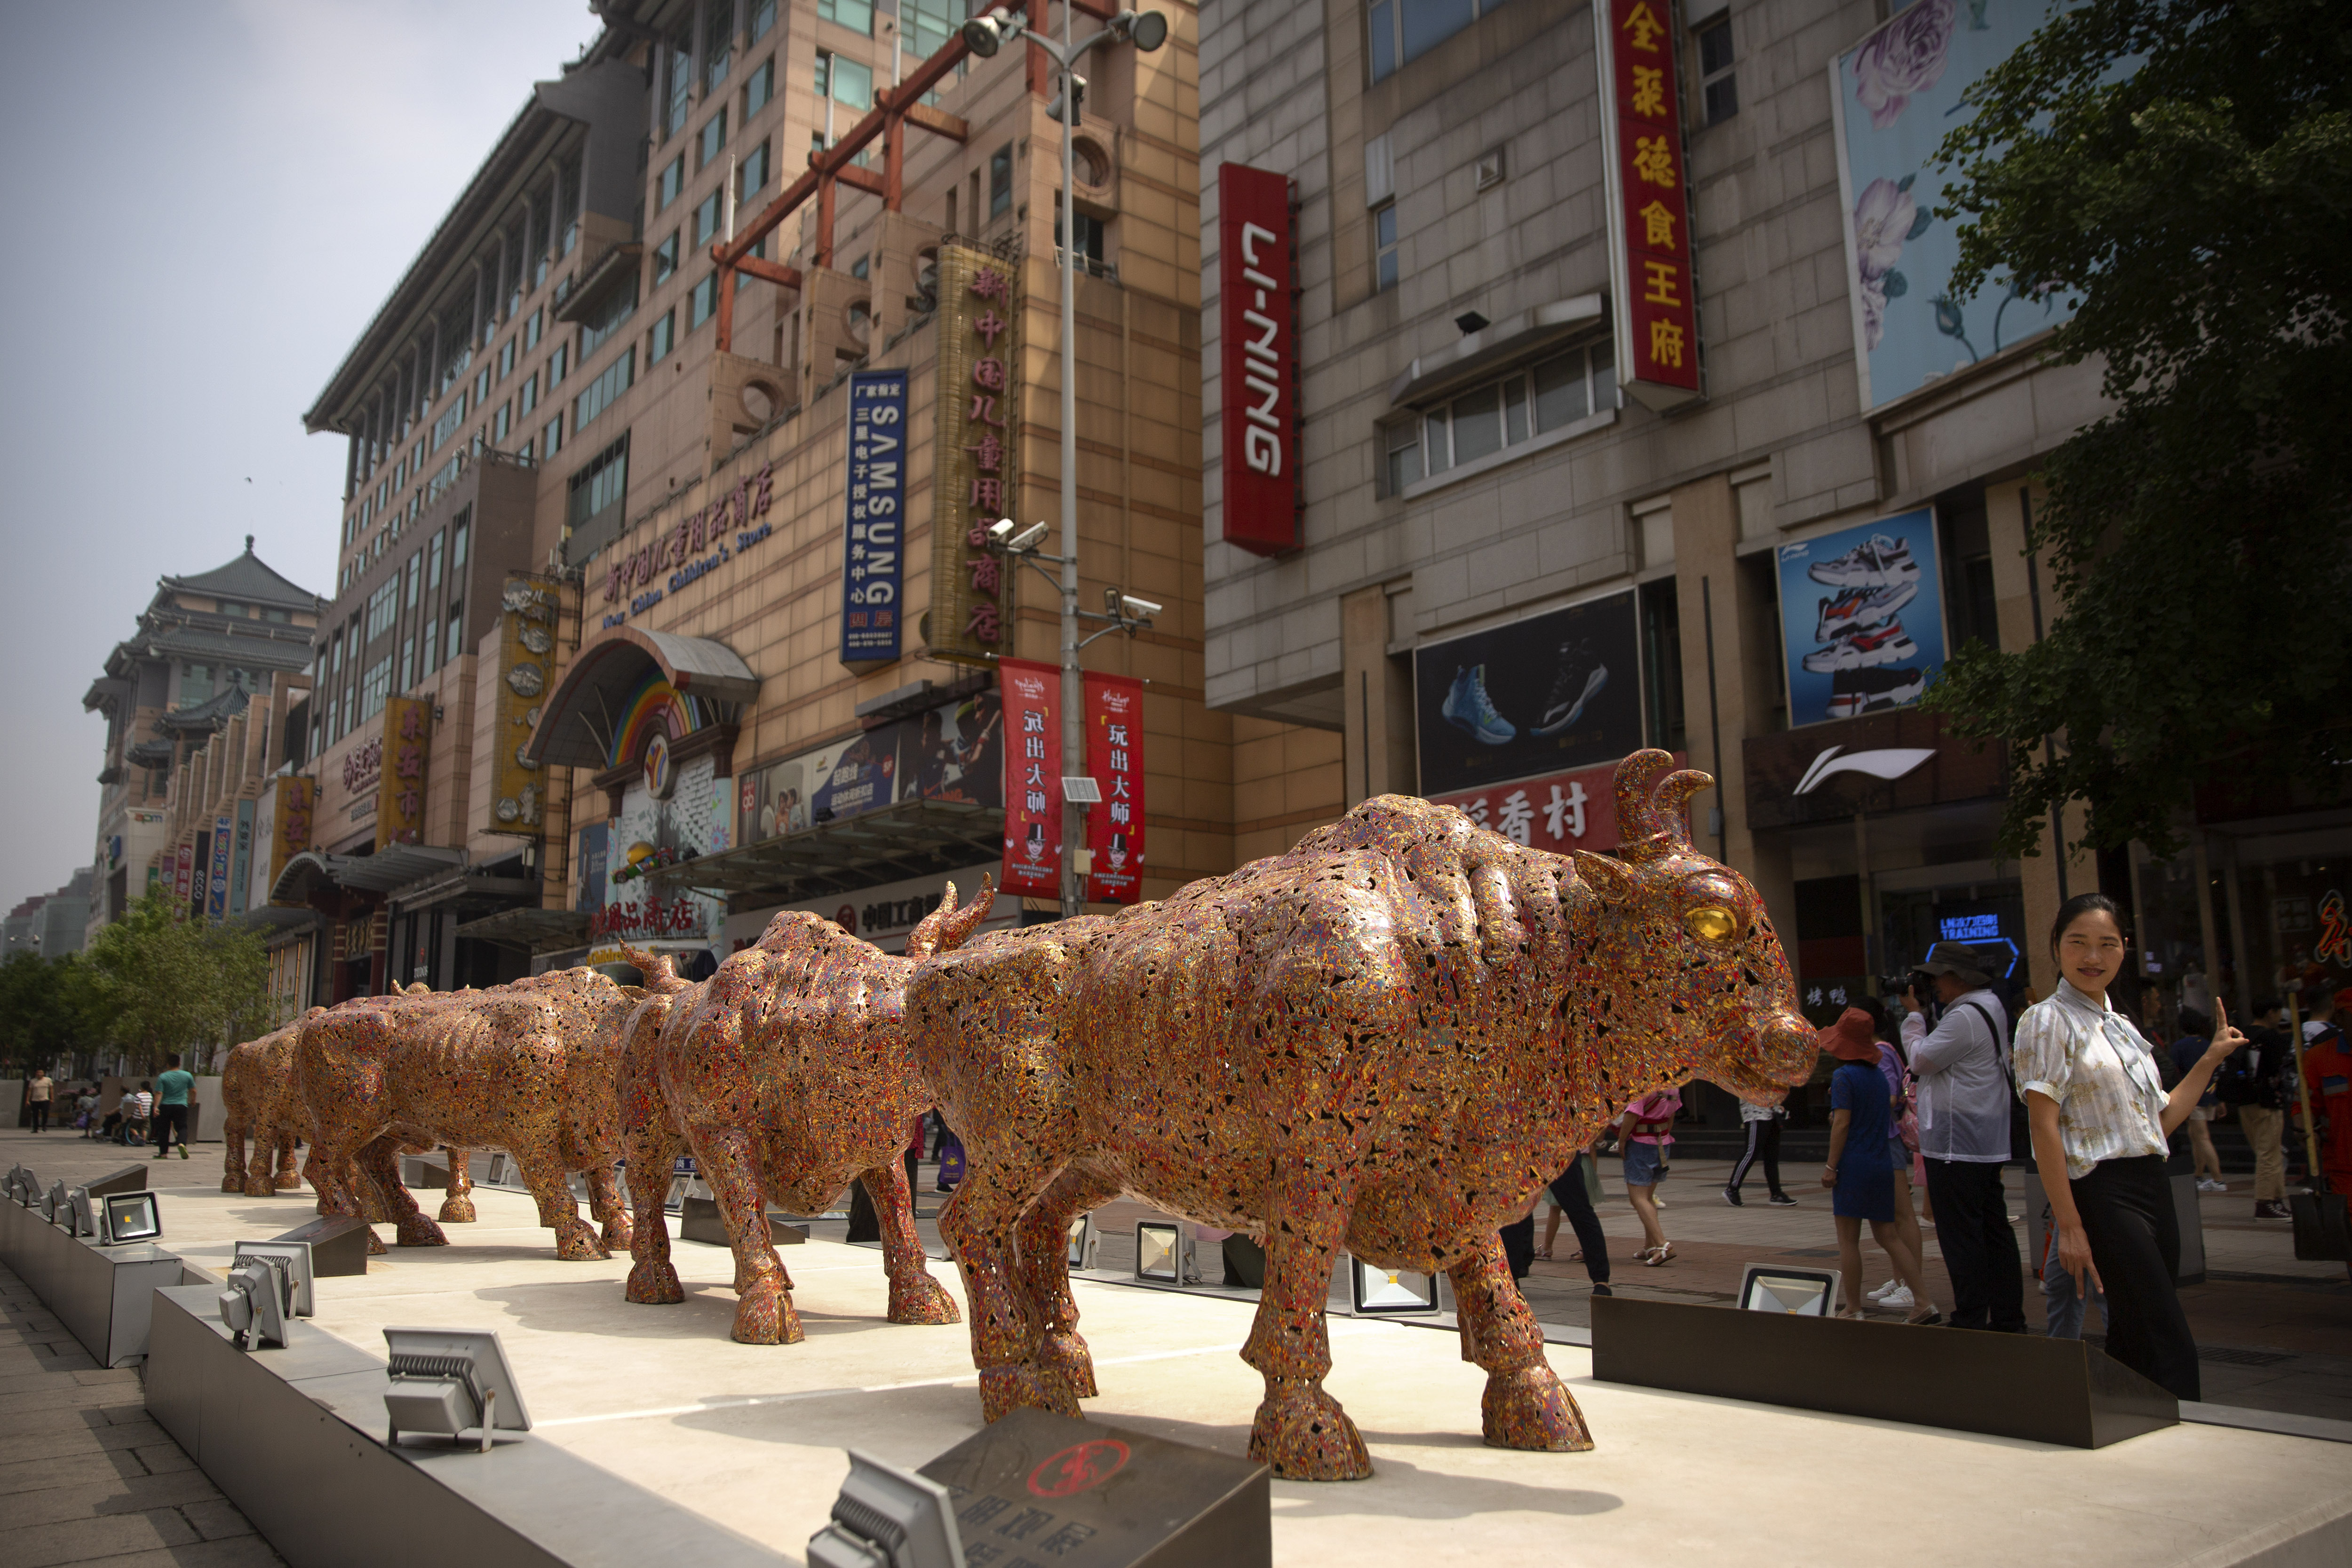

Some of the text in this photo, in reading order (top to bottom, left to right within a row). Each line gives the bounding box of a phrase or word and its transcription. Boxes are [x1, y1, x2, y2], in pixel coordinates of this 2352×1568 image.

[1241, 221, 1282, 477] LI-NING
[855, 383, 900, 398] 厂家指定
[850, 407, 870, 604] 三星电子授权服务中心
[866, 405, 899, 604] SAMSUNG
[629, 588, 662, 617] China
[667, 542, 729, 593] Children's
[735, 522, 772, 553] Store
[135, 812, 163, 824] apm
[193, 870, 206, 900] ecco
[1941, 925, 1999, 941] TRAINING
[414, 965, 429, 979] TUDOR
[1807, 985, 1848, 1007] 烤鸭
